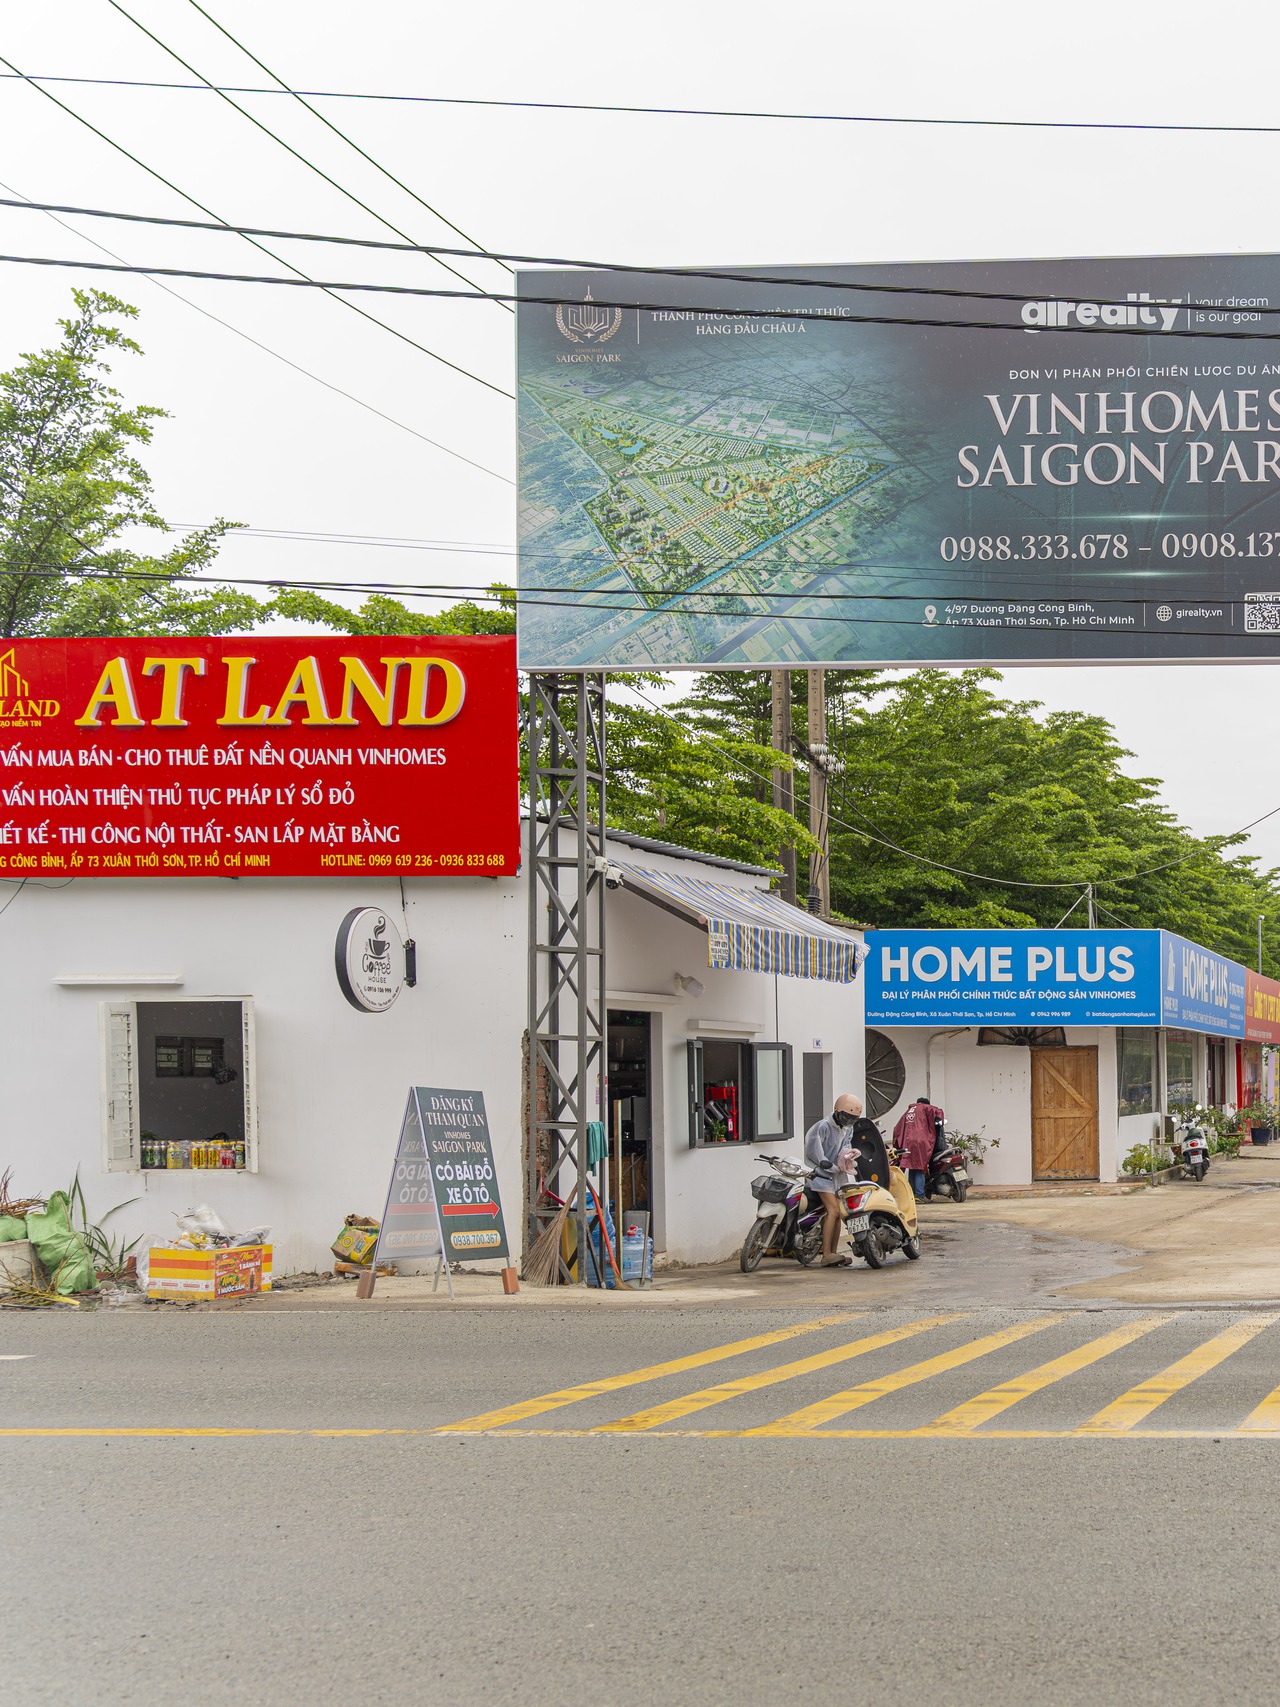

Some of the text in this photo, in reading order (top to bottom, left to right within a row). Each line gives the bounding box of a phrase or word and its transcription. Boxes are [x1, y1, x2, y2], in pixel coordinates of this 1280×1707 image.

[1227, 296, 1269, 307] dream
[1195, 311, 1262, 325] is our goal
[696, 321, 806, 335] HÀNG ĐẦU CHÂU Á
[556, 354, 622, 363] SAIGON PARK
[1009, 369, 1039, 380] ĐƠN
[1044, 369, 1058, 380] VỊ
[1063, 367, 1101, 378] PHÂN
[1107, 365, 1141, 378] PHỐI
[1146, 364, 1190, 377] CHIẾN
[1195, 365, 1232, 378] LƯỢC
[1237, 364, 1257, 377] DỰ
[957, 442, 1169, 488] SAIGON
[940, 534, 1129, 562] 0988.333.678
[944, 605, 967, 614] 4/97
[1038, 603, 1066, 614] Công
[1176, 607, 1223, 619] girealty.vn
[74, 655, 467, 727] AT LAND
[1, 740, 447, 769] VẤN MUA BÁN CHO THUÊ ĐẤT NỀN QUANH VINHOMES
[2, 779, 355, 810] VẤN HOÀN THIỆN THỦ TỤC PHÁP LÝ SỔ ĐỎ
[59, 818, 400, 848] THI CÔNG NỘI THẤT SAN LẤP MẶT BẰNG
[320, 854, 505, 867] HOTLINE: 0969 619 236 0936 833 688
[882, 945, 1136, 983] HOME PLUS
[1182, 946, 1208, 1004] HOME
[1210, 960, 1229, 1008] PLUS
[882, 989, 1136, 1001] ĐẠI LÝ PHÂN PHỐI CHÍNH THỨC BẤT ĐỘNG SẢN VINHOMES
[431, 1096, 475, 1111] ĐĂNG KÝ
[425, 1112, 485, 1128] THAM QUAN
[444, 1131, 471, 1139] VINHOMES
[432, 1141, 487, 1153] SAIGON PARK
[435, 1157, 493, 1181] CÓ BÃI ĐỖ
[448, 1183, 490, 1204] XE Ô TÔ
[453, 1233, 499, 1247] 0938.700.367
